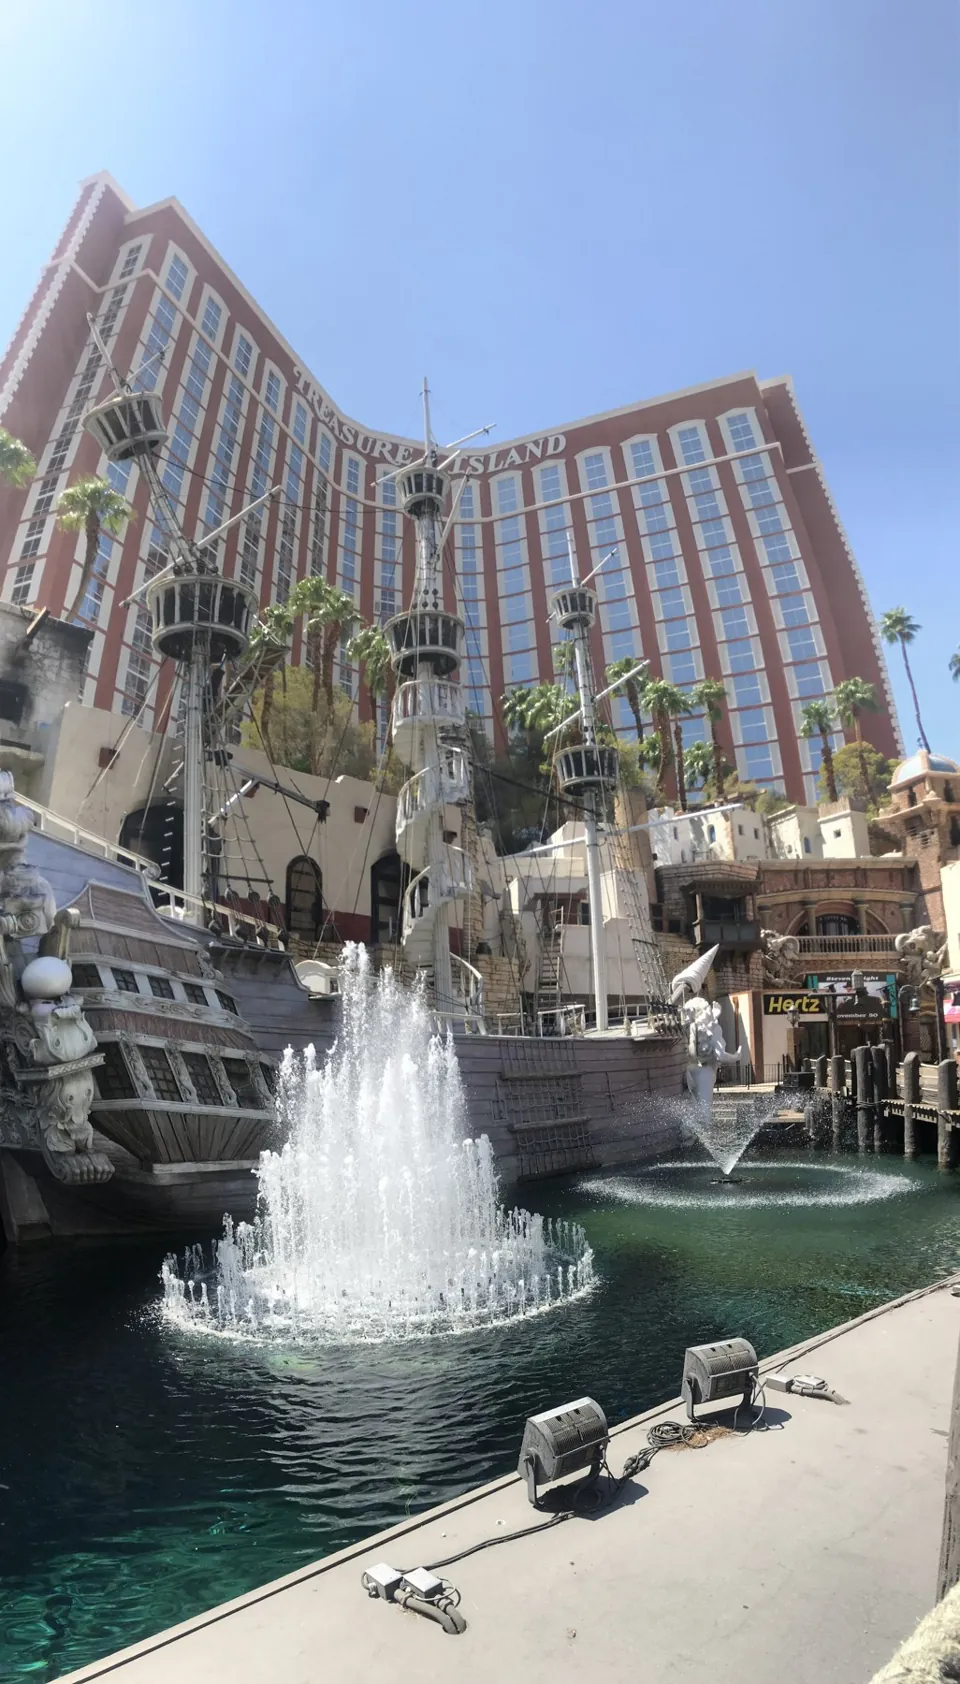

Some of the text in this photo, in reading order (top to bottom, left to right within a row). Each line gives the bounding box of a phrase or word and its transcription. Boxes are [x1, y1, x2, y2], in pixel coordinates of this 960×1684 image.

[293, 365, 566, 475] TREASURE ISLAND
[768, 996, 820, 1012] Hertz
